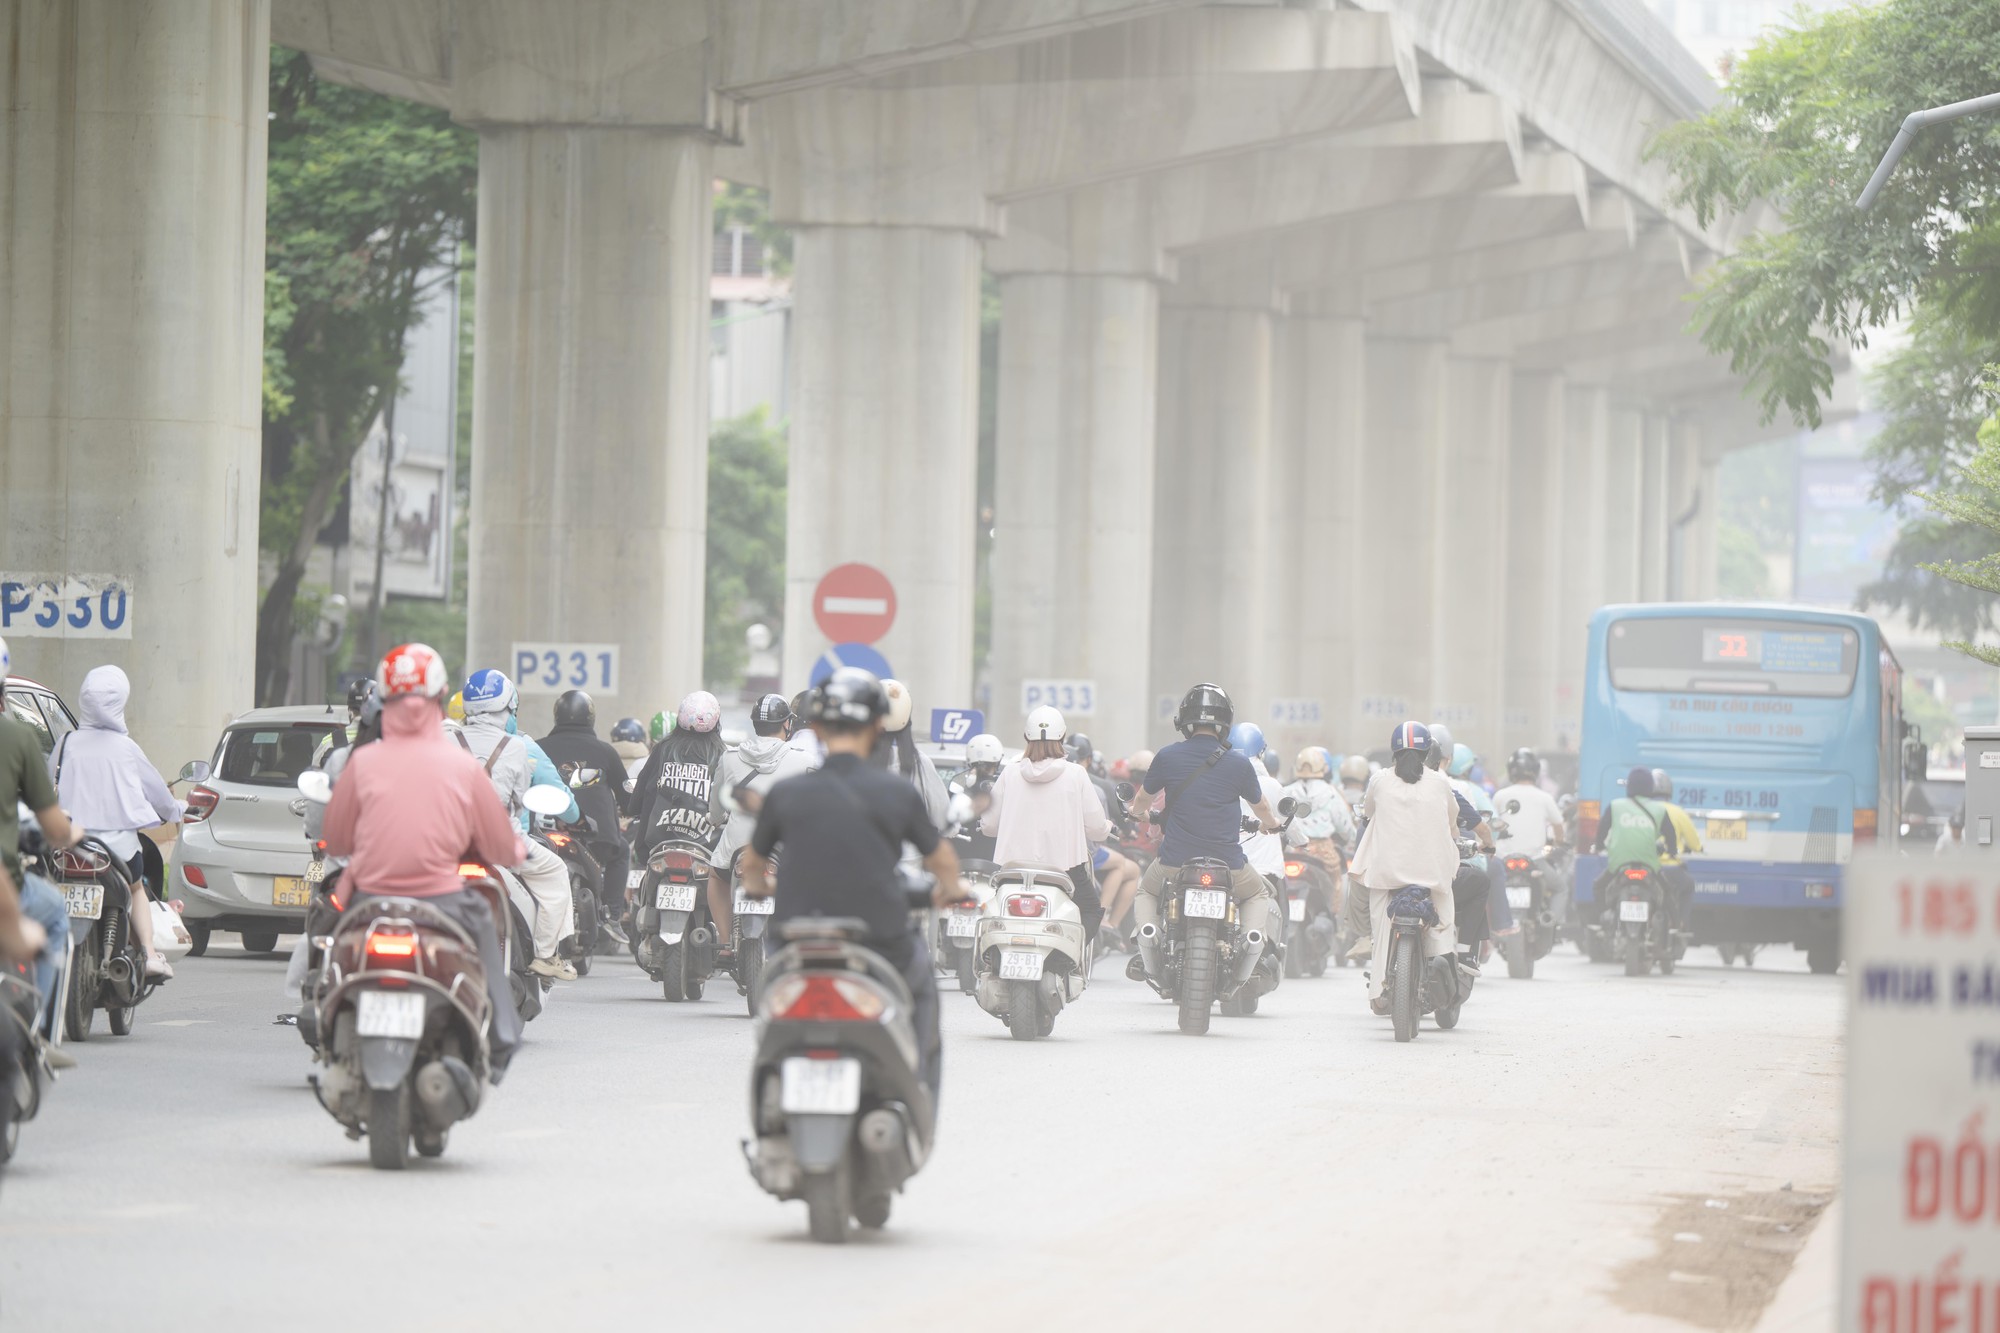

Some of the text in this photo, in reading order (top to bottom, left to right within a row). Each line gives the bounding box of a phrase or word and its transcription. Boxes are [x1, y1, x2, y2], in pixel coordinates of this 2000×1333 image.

[1, 582, 127, 630] P330
[516, 650, 611, 688] P331
[1026, 685, 1092, 711] P333
[664, 763, 709, 780] STRAIGHT
[1724, 789, 1779, 809] 051.80
[1620, 812, 1654, 829] Gra
[663, 886, 690, 898] 29-P1
[657, 897, 692, 910] 734.92
[1007, 953, 1038, 965] 29-B1
